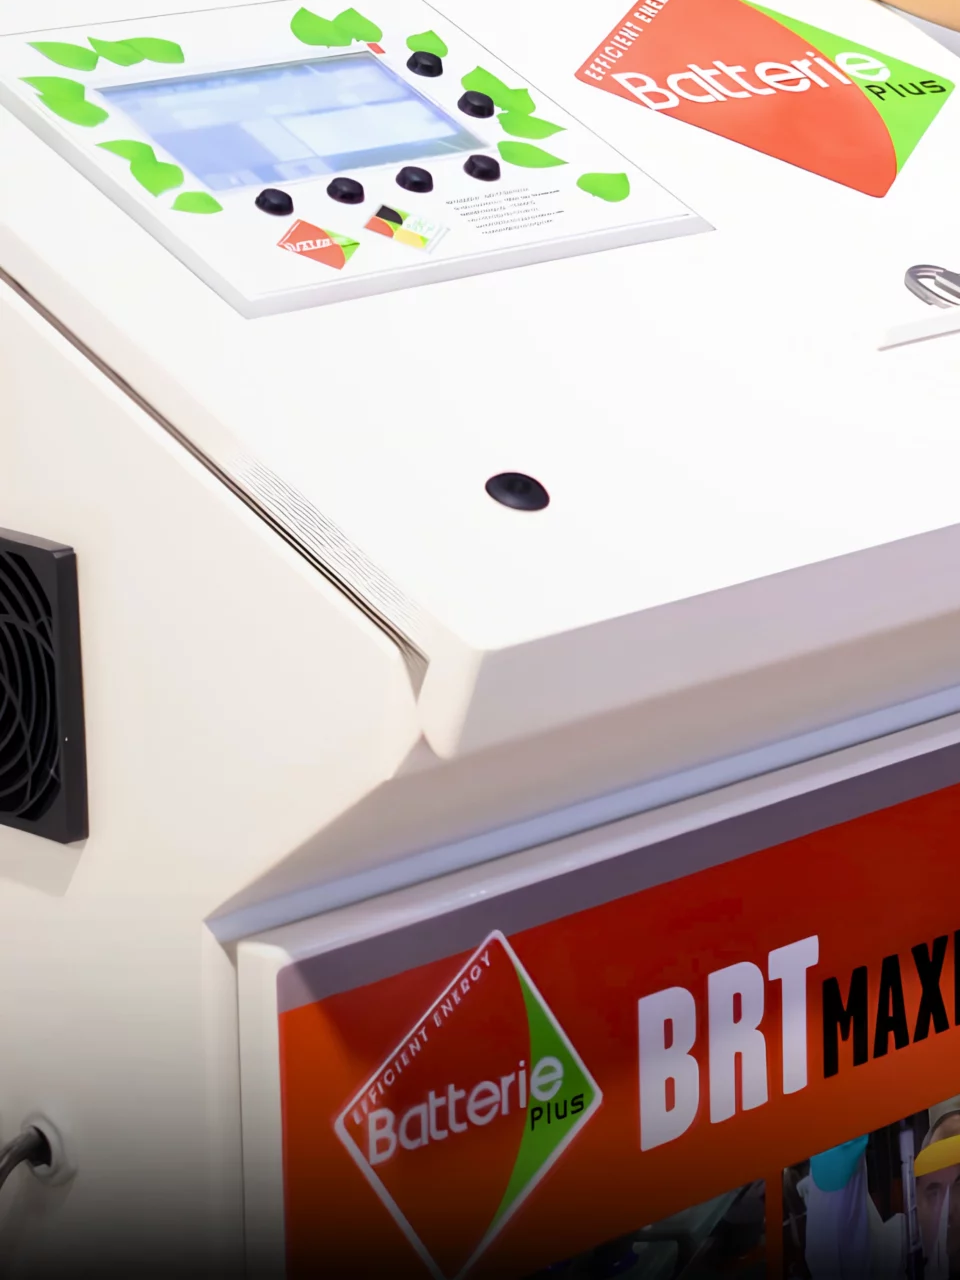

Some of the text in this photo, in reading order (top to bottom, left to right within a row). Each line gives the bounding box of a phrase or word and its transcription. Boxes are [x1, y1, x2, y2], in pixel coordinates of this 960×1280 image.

[584, 21, 643, 81] EFFICIENT
[610, 52, 891, 111] Batterie
[866, 79, 946, 102] Plus
[638, 935, 819, 1153] BRT
[368, 1056, 564, 1166] Batterie
[531, 1093, 585, 1131] Plus
